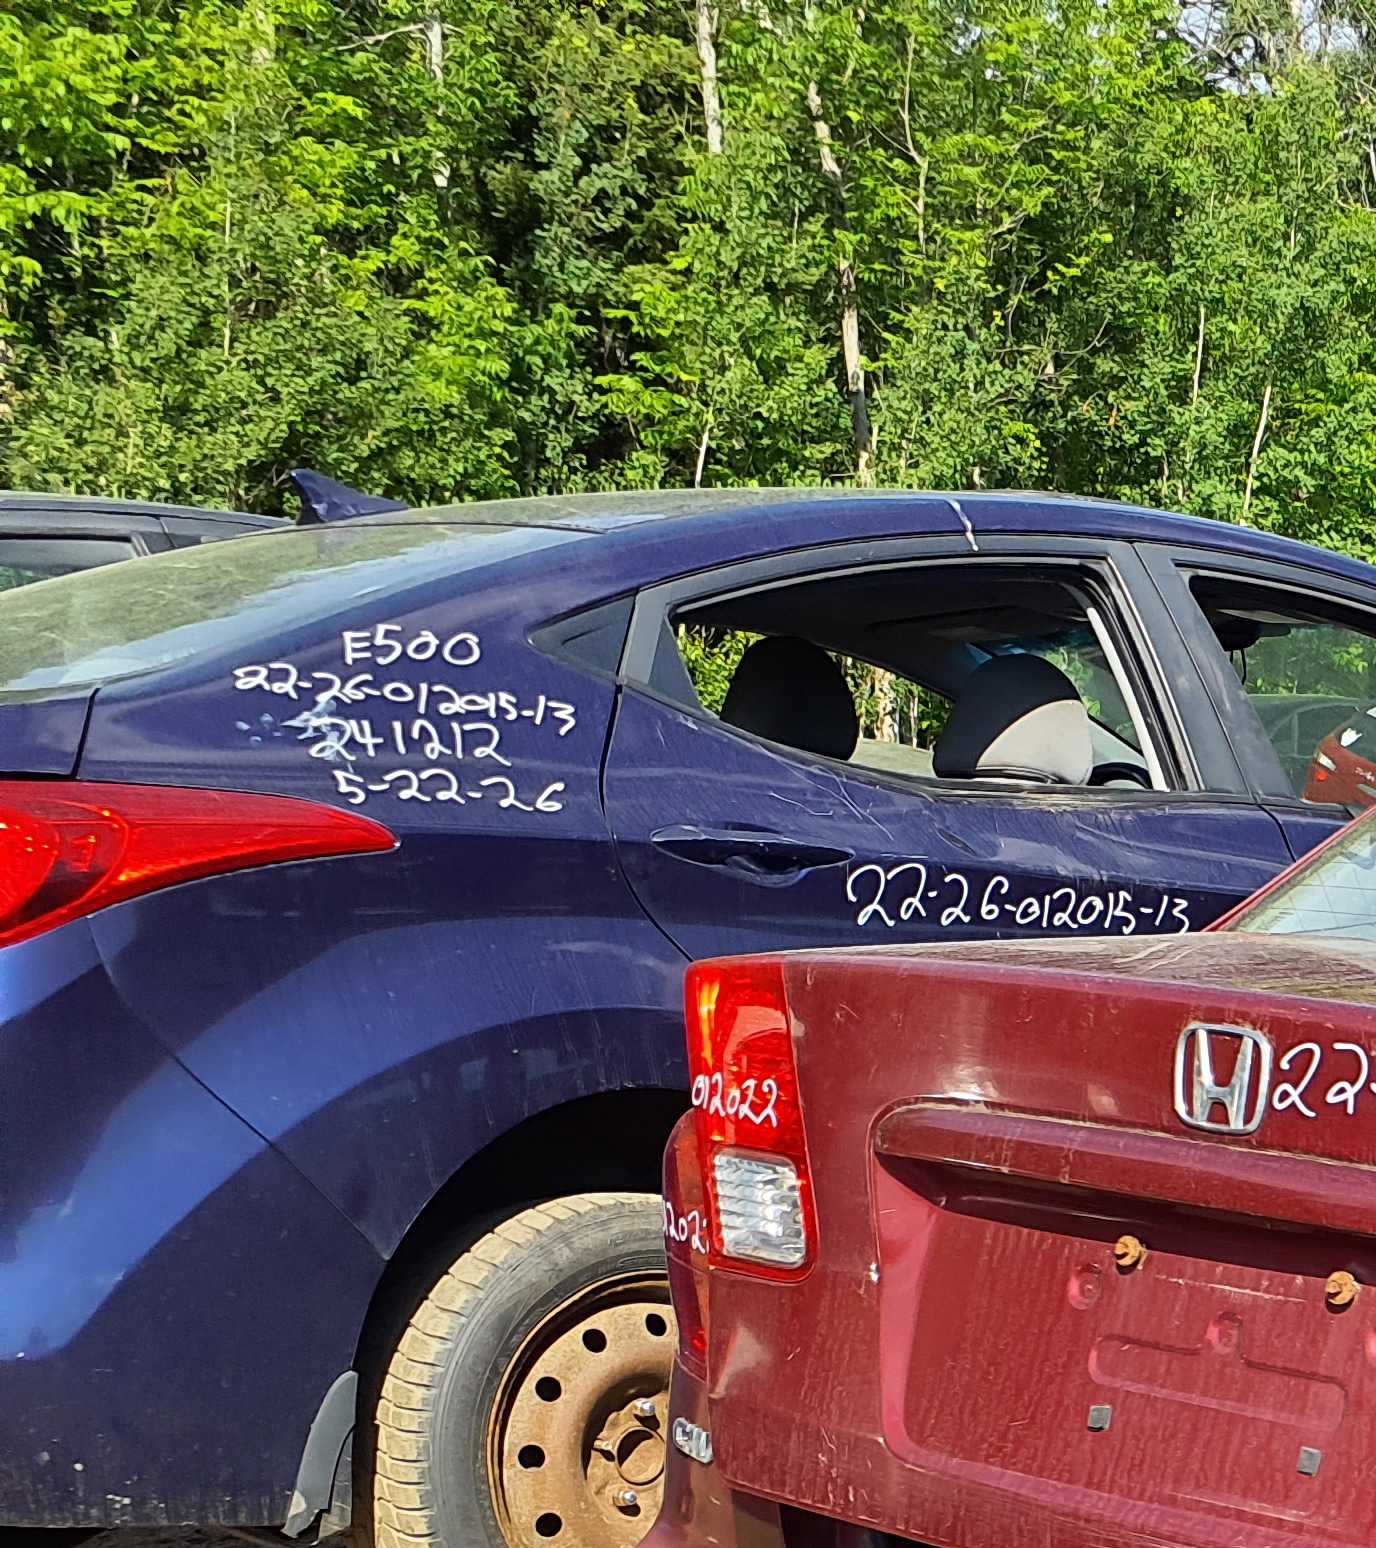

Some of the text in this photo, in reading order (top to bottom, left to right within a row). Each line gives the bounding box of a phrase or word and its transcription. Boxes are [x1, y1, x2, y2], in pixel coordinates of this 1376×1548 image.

[343, 623, 482, 666] E500
[332, 769, 567, 813] 5-22-26
[691, 1071, 779, 1129] 012022
